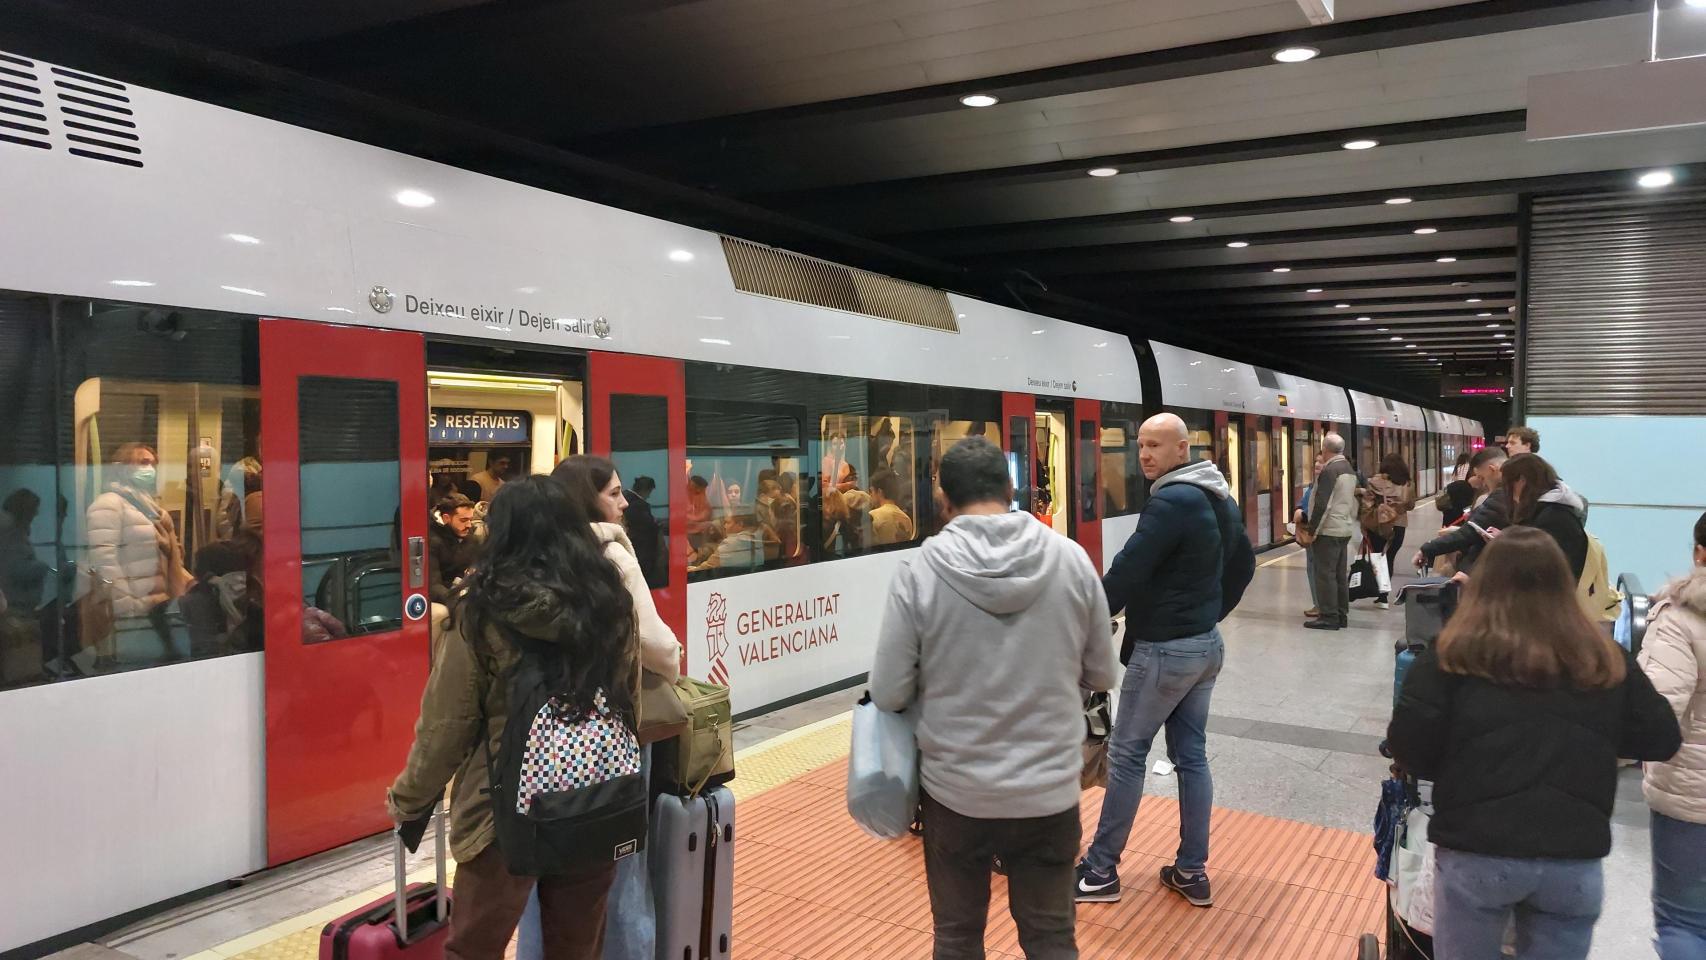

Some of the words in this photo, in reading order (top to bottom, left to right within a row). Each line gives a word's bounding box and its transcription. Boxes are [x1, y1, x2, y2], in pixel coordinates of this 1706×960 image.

[405, 295, 465, 319] Deixeu
[471, 305, 504, 324] eixir
[519, 310, 560, 333] Dejen
[564, 319, 592, 335] salir
[446, 415, 520, 430] RESERVATS
[737, 593, 840, 636] GENERALITAT
[739, 623, 839, 667] VALENCIANA
